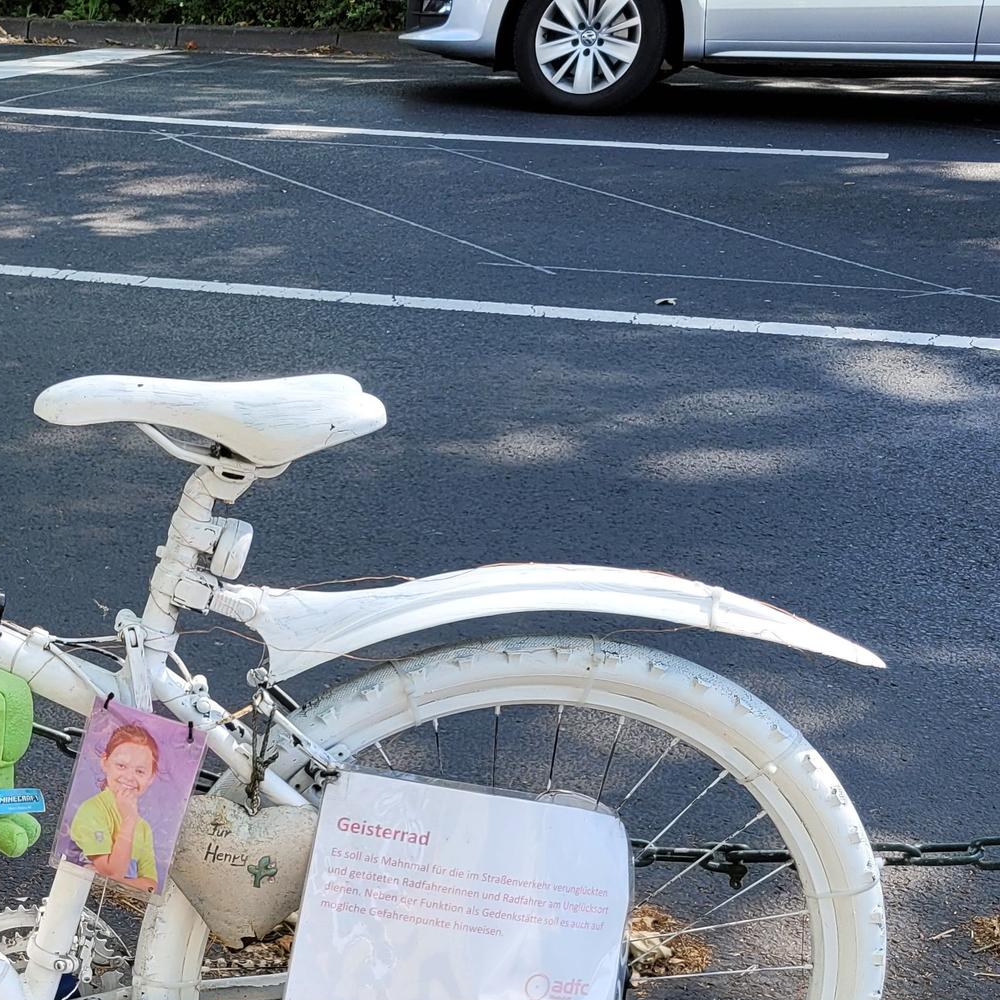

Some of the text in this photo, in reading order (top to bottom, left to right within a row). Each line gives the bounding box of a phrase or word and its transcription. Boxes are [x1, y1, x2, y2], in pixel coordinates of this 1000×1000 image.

[337, 817, 431, 846] Geisterrad
[204, 843, 249, 867] Henry
[331, 847, 342, 857] Es
[344, 850, 362, 861] soll
[364, 853, 379, 864] als
[381, 856, 430, 873] Mahnmal
[432, 864, 447, 875] für
[449, 867, 464, 878] die
[466, 870, 479, 881] im
[482, 873, 551, 890] Straßenverkehr
[328, 865, 348, 877] und
[402, 877, 480, 899] Radfahrerinnen
[482, 891, 501, 902] und
[503, 893, 546, 908] Radfahrer
[548, 901, 561, 910] am
[364, 888, 398, 903] Neben
[400, 893, 418, 906] der
[420, 897, 464, 914] Funktion
[466, 904, 480, 916] als
[544, 916, 560, 927] soll
[560, 920, 569, 929] es
[571, 920, 590, 930] auch
[591, 921, 604, 931] auf
[369, 906, 451, 929] Gefahrenpunkte
[452, 920, 504, 937] hinweisen.
[551, 978, 590, 996] adfc
